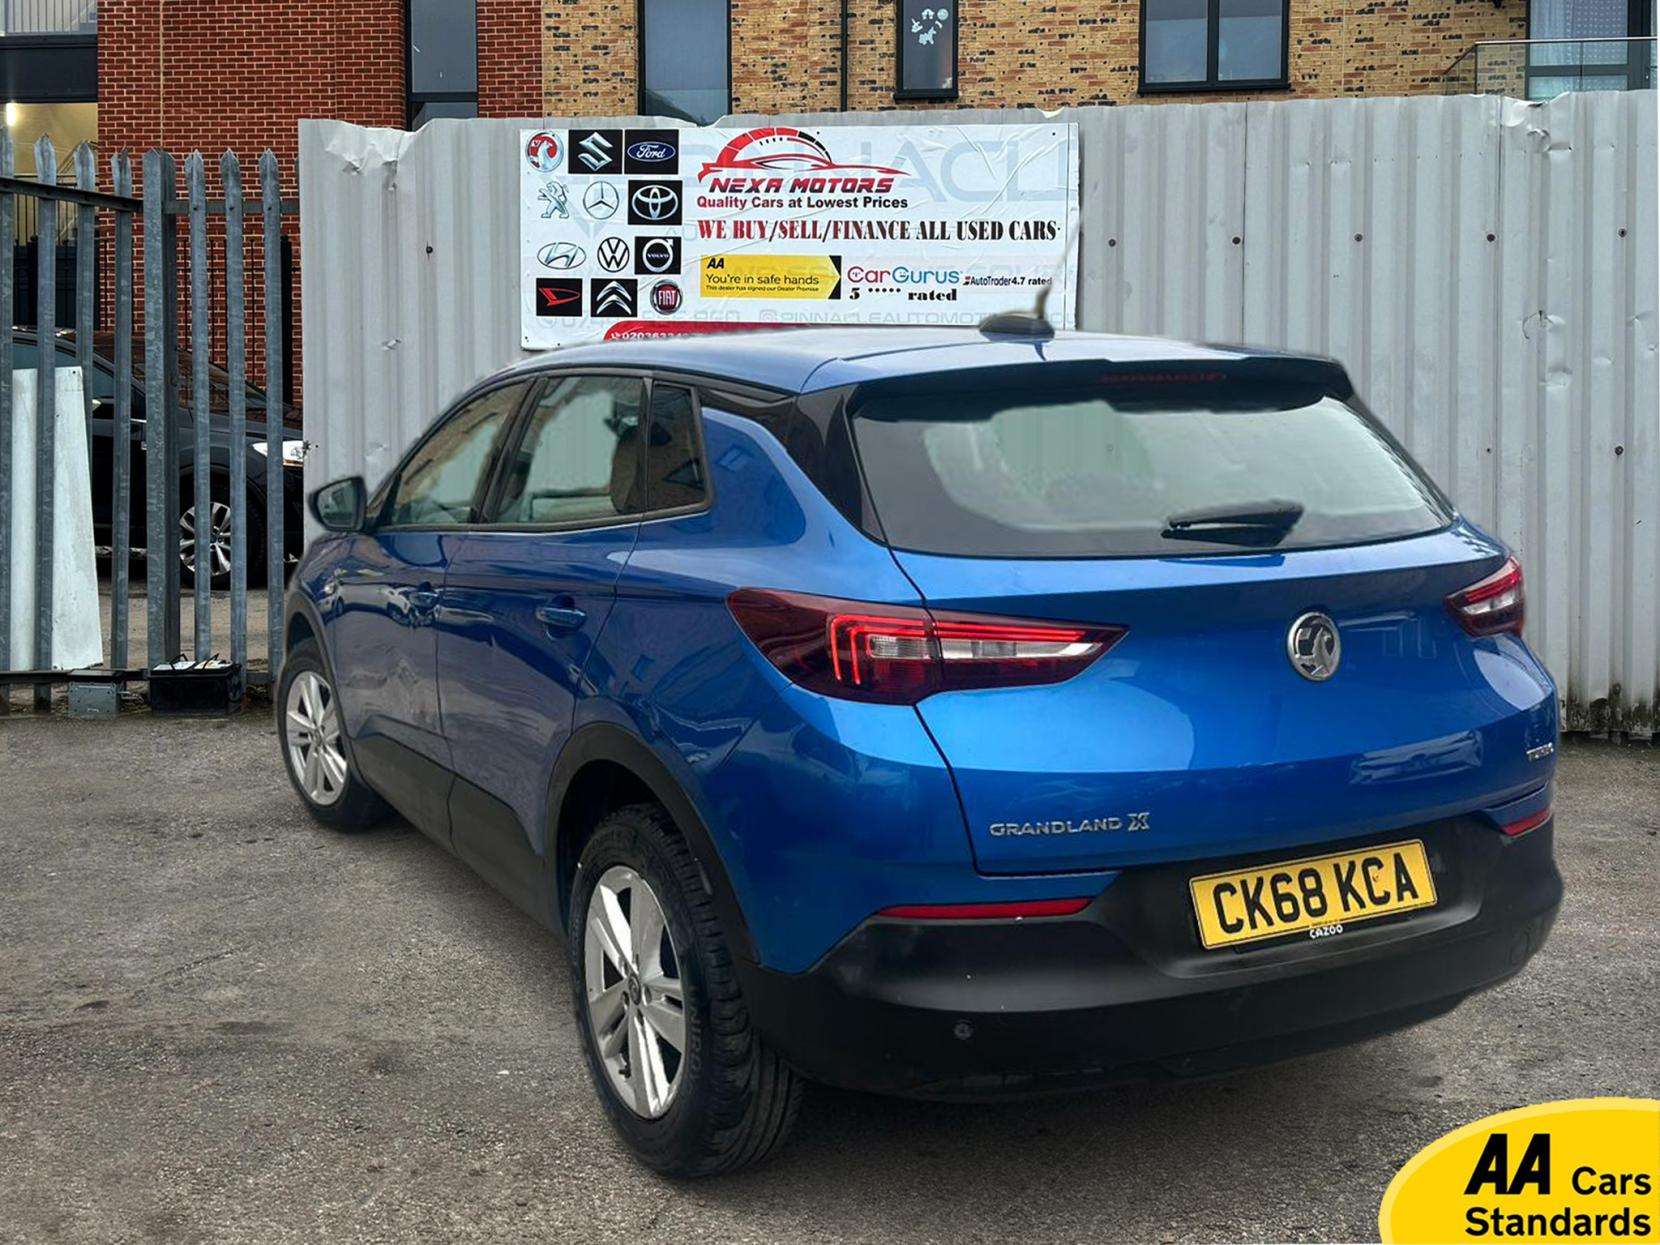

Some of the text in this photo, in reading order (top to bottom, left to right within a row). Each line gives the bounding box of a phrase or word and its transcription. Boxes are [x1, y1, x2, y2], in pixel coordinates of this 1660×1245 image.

[636, 144, 666, 159] Ford
[709, 177, 895, 194] NEXA MOTORS
[697, 196, 909, 210] Quality Cars at Lowest Prices
[697, 220, 727, 240] WE
[915, 220, 950, 241] ALL
[957, 220, 1004, 241] USED
[1009, 220, 1057, 241] CARS
[706, 257, 725, 269] AA
[705, 273, 820, 285] You're in safe hands
[847, 266, 960, 284] CarGurus
[1028, 277, 1053, 286] rated
[658, 290, 677, 306] FIAT
[849, 287, 958, 301] 5 rated
[989, 811, 1151, 837] GRANDLAND X
[1212, 852, 1420, 935] CK68 KCA
[1309, 924, 1344, 939] CAZOO
